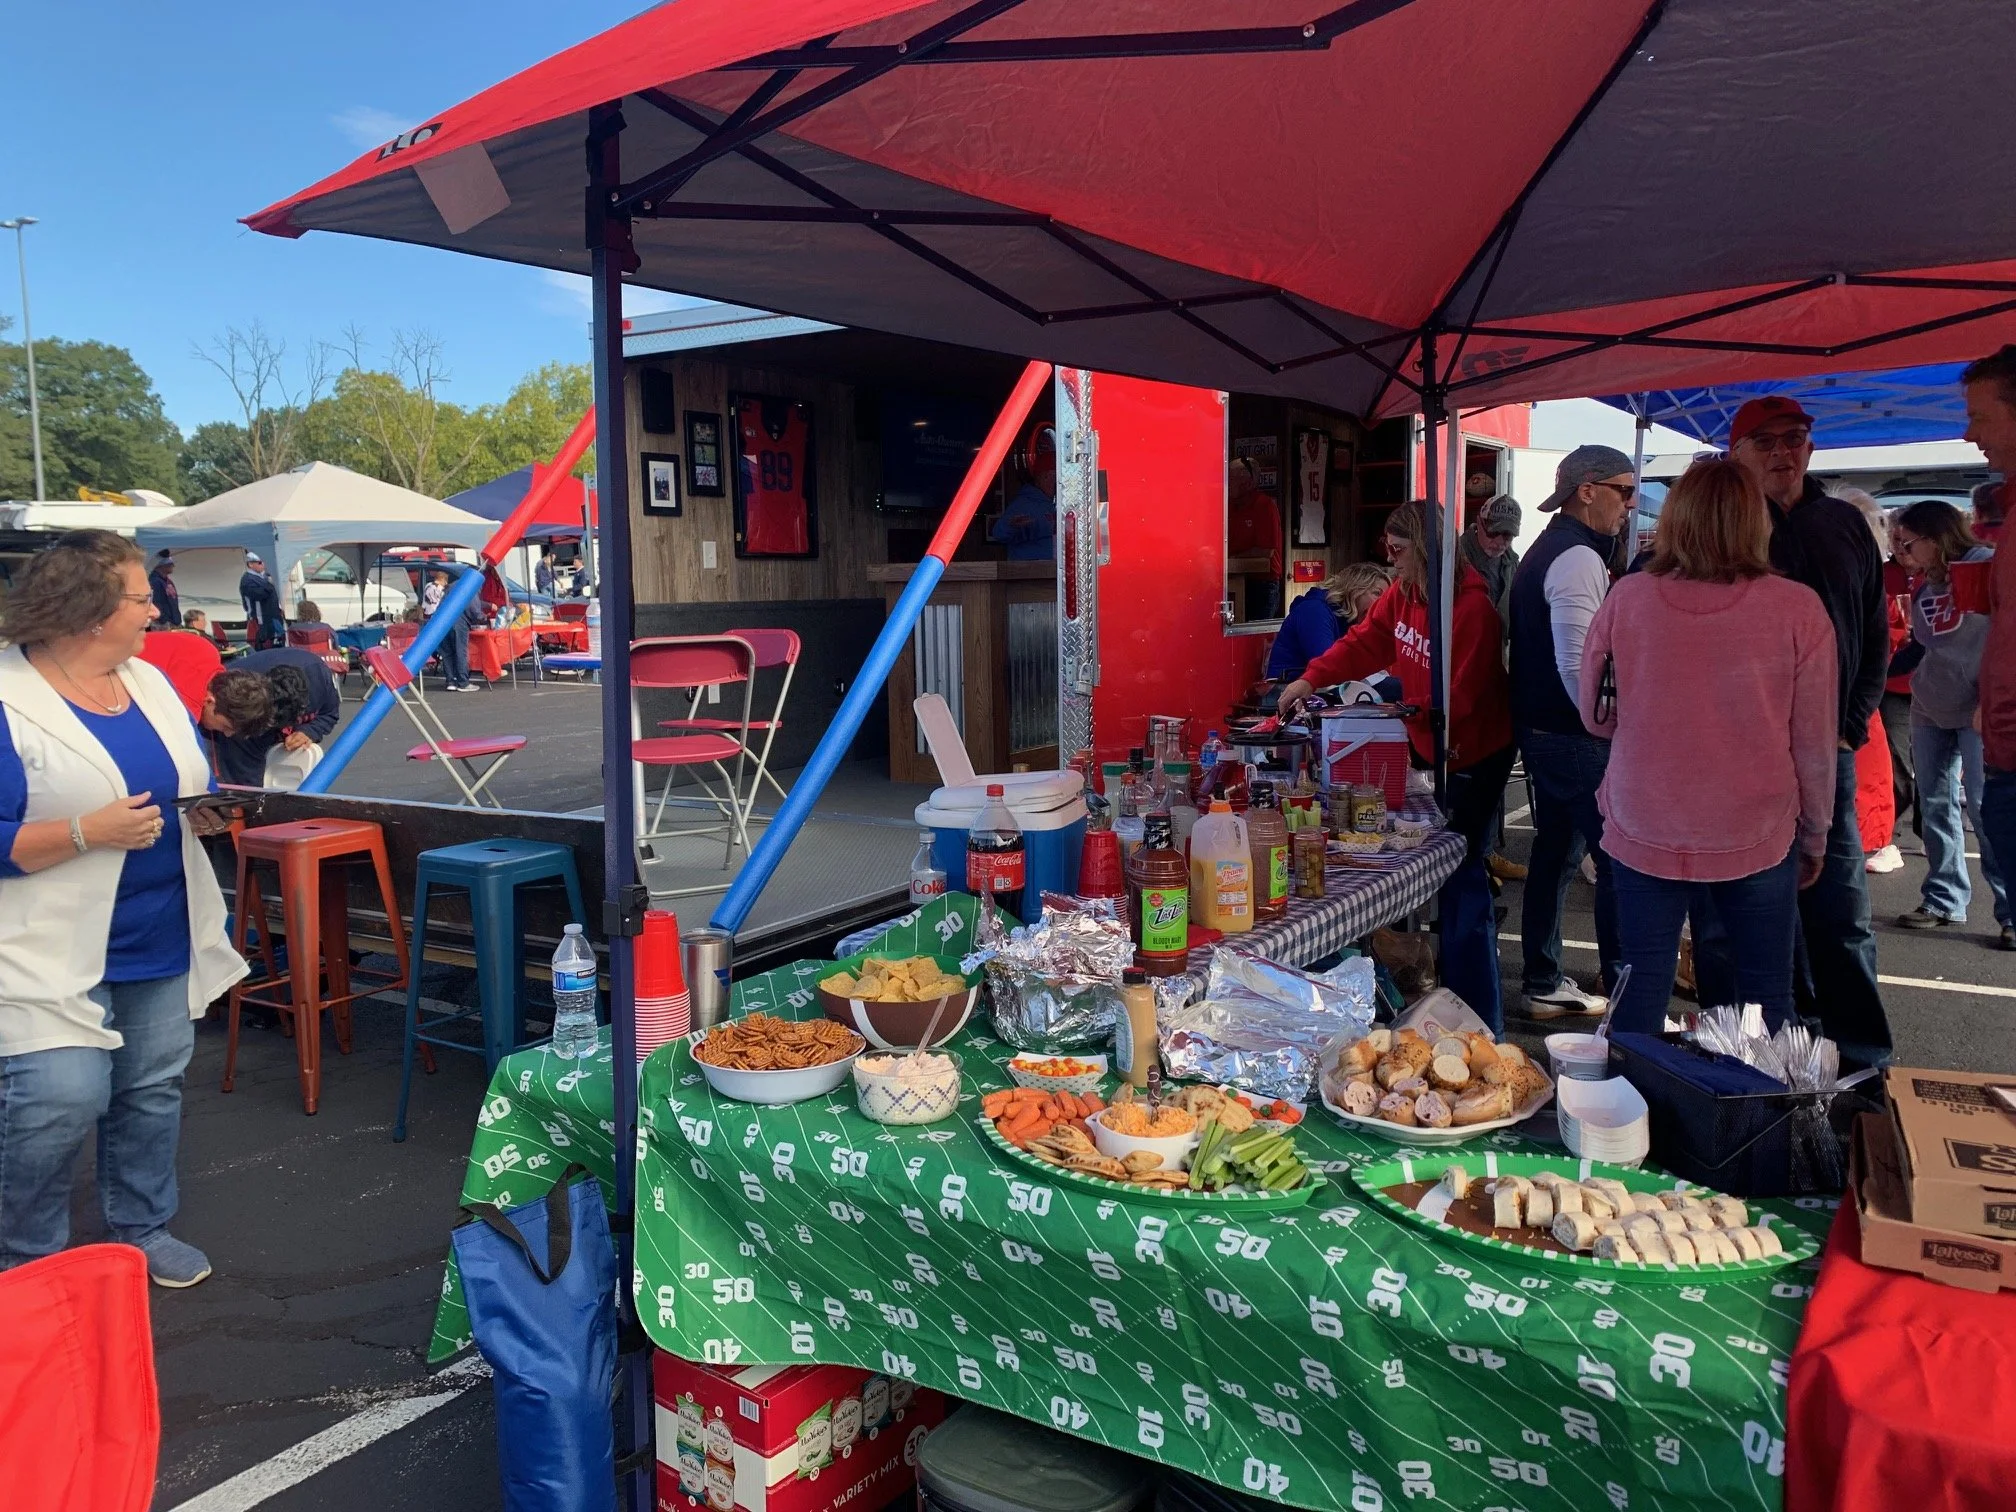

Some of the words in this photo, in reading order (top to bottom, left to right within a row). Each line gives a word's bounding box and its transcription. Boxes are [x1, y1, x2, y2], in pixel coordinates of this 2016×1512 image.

[760, 449, 793, 492] 89
[1308, 471, 1320, 502] 15
[912, 879, 946, 895] Coke
[935, 912, 963, 941] 30
[677, 1116, 713, 1146] 50
[744, 1123, 761, 1147] 40
[815, 1131, 839, 1143] 30
[483, 1144, 522, 1178] 50
[771, 1142, 795, 1183] 30
[831, 1146, 868, 1177] 50
[905, 1157, 925, 1180] 40
[653, 1187, 664, 1211] 50
[740, 1171, 765, 1202] 10
[939, 1174, 967, 1221] 30
[1007, 1182, 1053, 1216] 50
[829, 1201, 865, 1223] 40
[901, 1204, 929, 1236] 10
[1097, 1200, 1117, 1220] 40
[1319, 1206, 1360, 1228] 20
[1002, 1240, 1043, 1265] 40
[1135, 1216, 1168, 1265] 30
[1215, 1227, 1271, 1261] 50
[685, 1262, 710, 1279] 30
[906, 1253, 938, 1285] 20
[1087, 1249, 1120, 1280] 10
[1323, 1246, 1348, 1268] 40
[1435, 1262, 1471, 1280] 30
[713, 1277, 755, 1305] 50
[850, 1289, 873, 1302] 30
[893, 1280, 911, 1293] 10
[1367, 1264, 1407, 1317] 30
[1520, 1277, 1549, 1288] 10
[1680, 1287, 1706, 1302] 50
[657, 1285, 676, 1328] 30
[824, 1297, 850, 1331] 30
[1090, 1297, 1123, 1331] 20
[1206, 1288, 1251, 1318] 40
[1464, 1282, 1528, 1317] 50
[879, 1303, 918, 1329] 50
[952, 1315, 967, 1333] 40
[1157, 1307, 1177, 1330] 50
[1310, 1296, 1343, 1339] 10
[1593, 1307, 1621, 1329] 40
[791, 1321, 815, 1355] 10
[1021, 1329, 1047, 1342] 30
[1070, 1324, 1092, 1338] 10
[1726, 1335, 1768, 1354] 30
[702, 1338, 742, 1364] 40
[882, 1350, 916, 1381] 40
[992, 1335, 1019, 1371] 30
[1054, 1347, 1097, 1375] 50
[1448, 1345, 1506, 1369] 40
[1649, 1332, 1696, 1388] 30
[957, 1355, 981, 1389] 10
[1137, 1362, 1154, 1384] 40
[1300, 1358, 1337, 1398] 20
[1381, 1359, 1406, 1388] 50
[1220, 1383, 1246, 1398] 30
[1275, 1383, 1298, 1399] 10
[1050, 1396, 1089, 1429] 40
[1182, 1383, 1210, 1430] 30
[1253, 1403, 1302, 1435] 50
[1138, 1406, 1164, 1448] 10
[1561, 1407, 1599, 1443] 20
[1348, 1431, 1366, 1453] 40
[1447, 1437, 1481, 1453] 30
[1656, 1437, 1679, 1464] 50
[833, 1470, 877, 1509] VARIETY
[880, 1455, 899, 1477] MIX
[1243, 1458, 1289, 1496] 40
[1398, 1461, 1435, 1499] 30
[1489, 1457, 1548, 1486] 50
[1352, 1471, 1383, 1512] 10
[1607, 1482, 1627, 1508] 40
